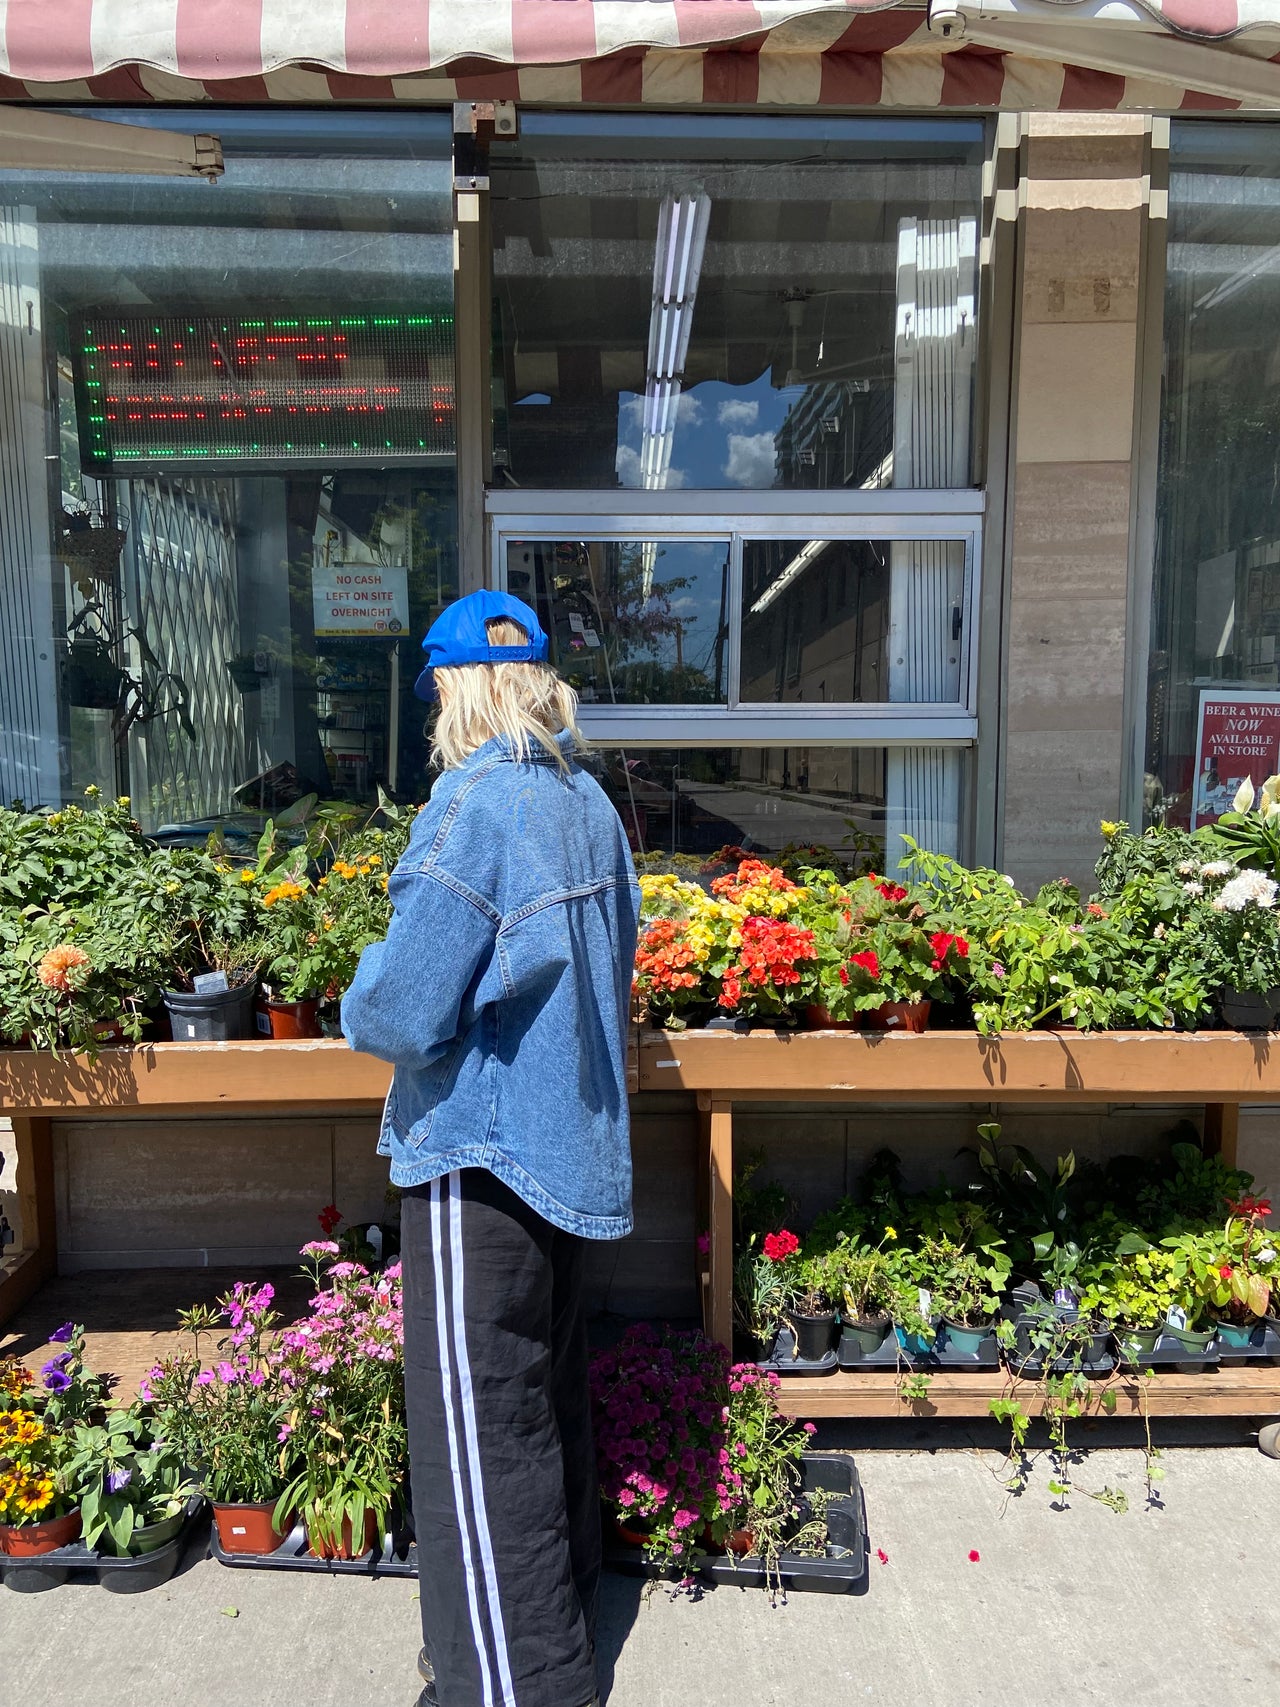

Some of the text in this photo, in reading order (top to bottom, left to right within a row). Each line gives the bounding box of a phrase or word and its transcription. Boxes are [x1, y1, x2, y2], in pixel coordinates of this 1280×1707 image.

[336, 575, 382, 585] NO CASH
[326, 591, 394, 601] LEFT ON SITE
[331, 608, 392, 617] OVERNIGHT
[1206, 705, 1237, 716] BEER
[1249, 706, 1280, 717] WINE
[1225, 719, 1264, 731] NOW
[1208, 734, 1274, 745] AVAILABLE
[1213, 745, 1267, 757] IN STORE
